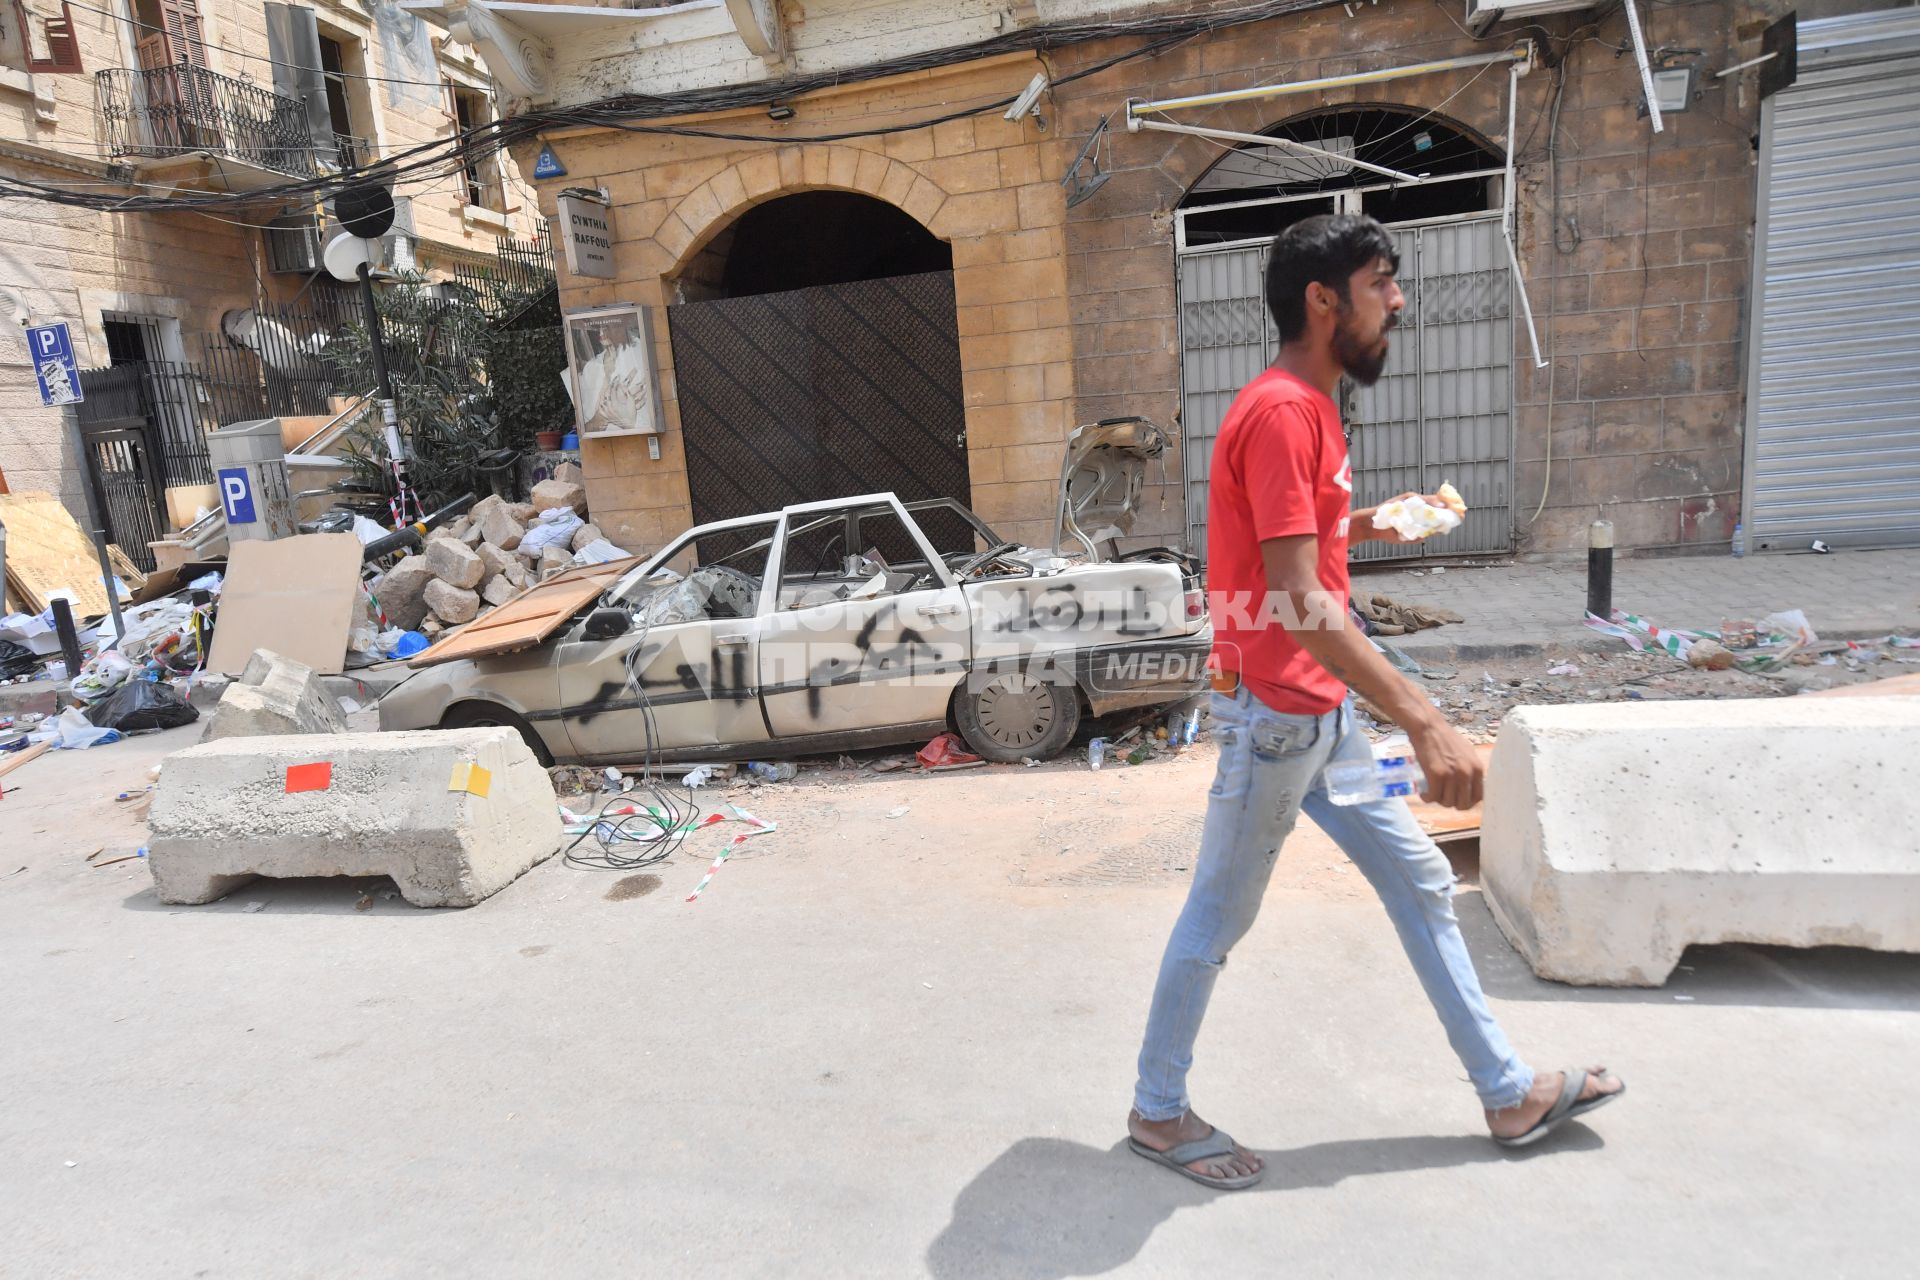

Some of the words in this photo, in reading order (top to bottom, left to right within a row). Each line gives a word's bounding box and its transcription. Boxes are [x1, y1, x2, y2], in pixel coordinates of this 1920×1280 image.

[537, 164, 557, 173] Chubb
[571, 214, 608, 231] CYNTHIA
[574, 232, 611, 249] RAFFOUL
[39, 330, 55, 354] P
[223, 477, 247, 517] P
